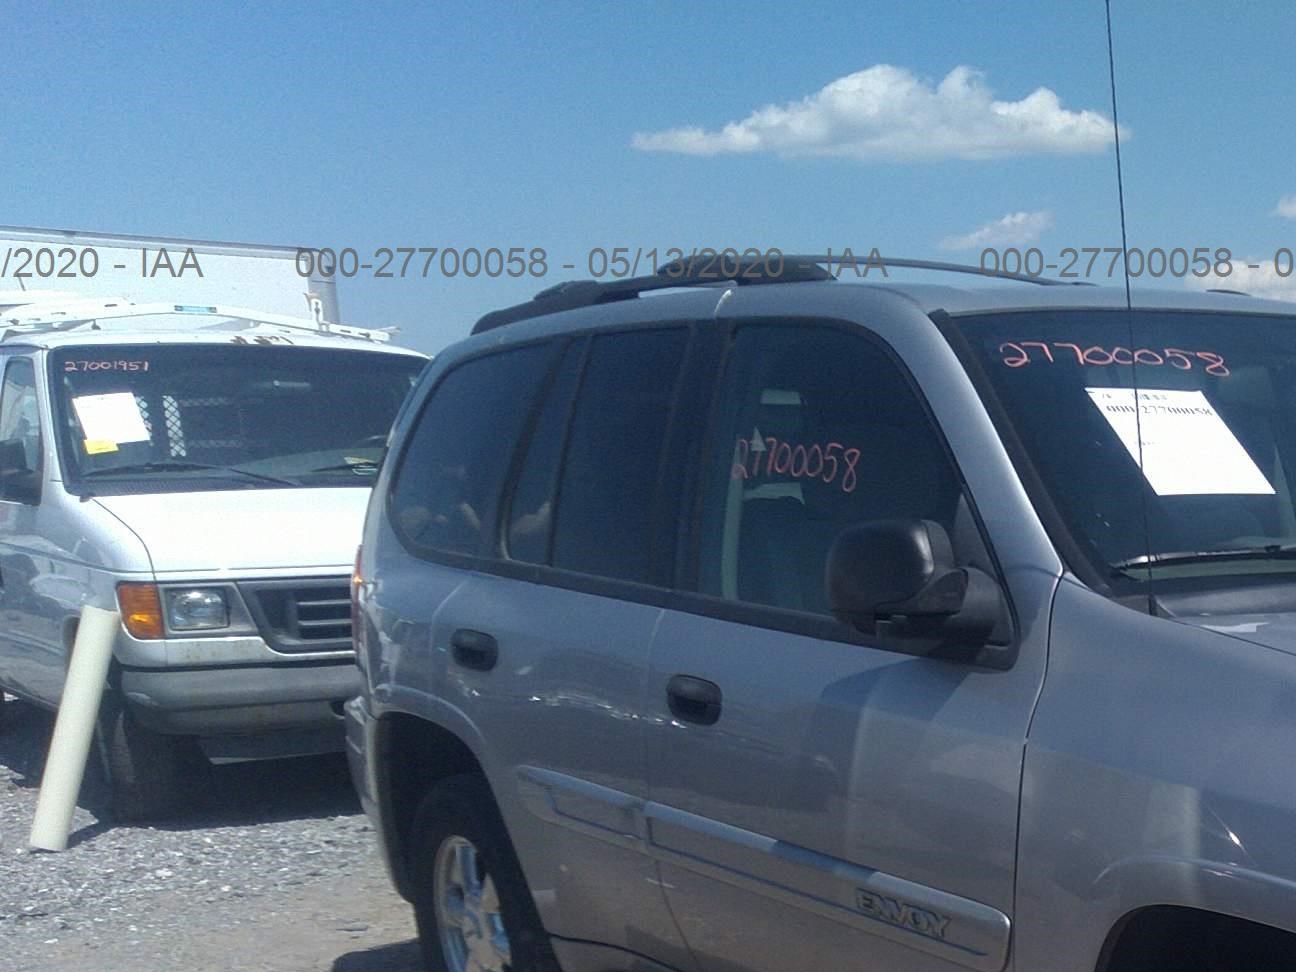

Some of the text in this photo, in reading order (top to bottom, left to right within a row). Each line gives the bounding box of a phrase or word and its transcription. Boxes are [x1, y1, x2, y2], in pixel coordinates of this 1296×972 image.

[64, 360, 150, 373] 27001951
[999, 342, 1231, 377] 27700058
[1105, 403, 1214, 417] 00027700058
[730, 437, 861, 493] 27700058
[854, 887, 952, 939] ENVOY
